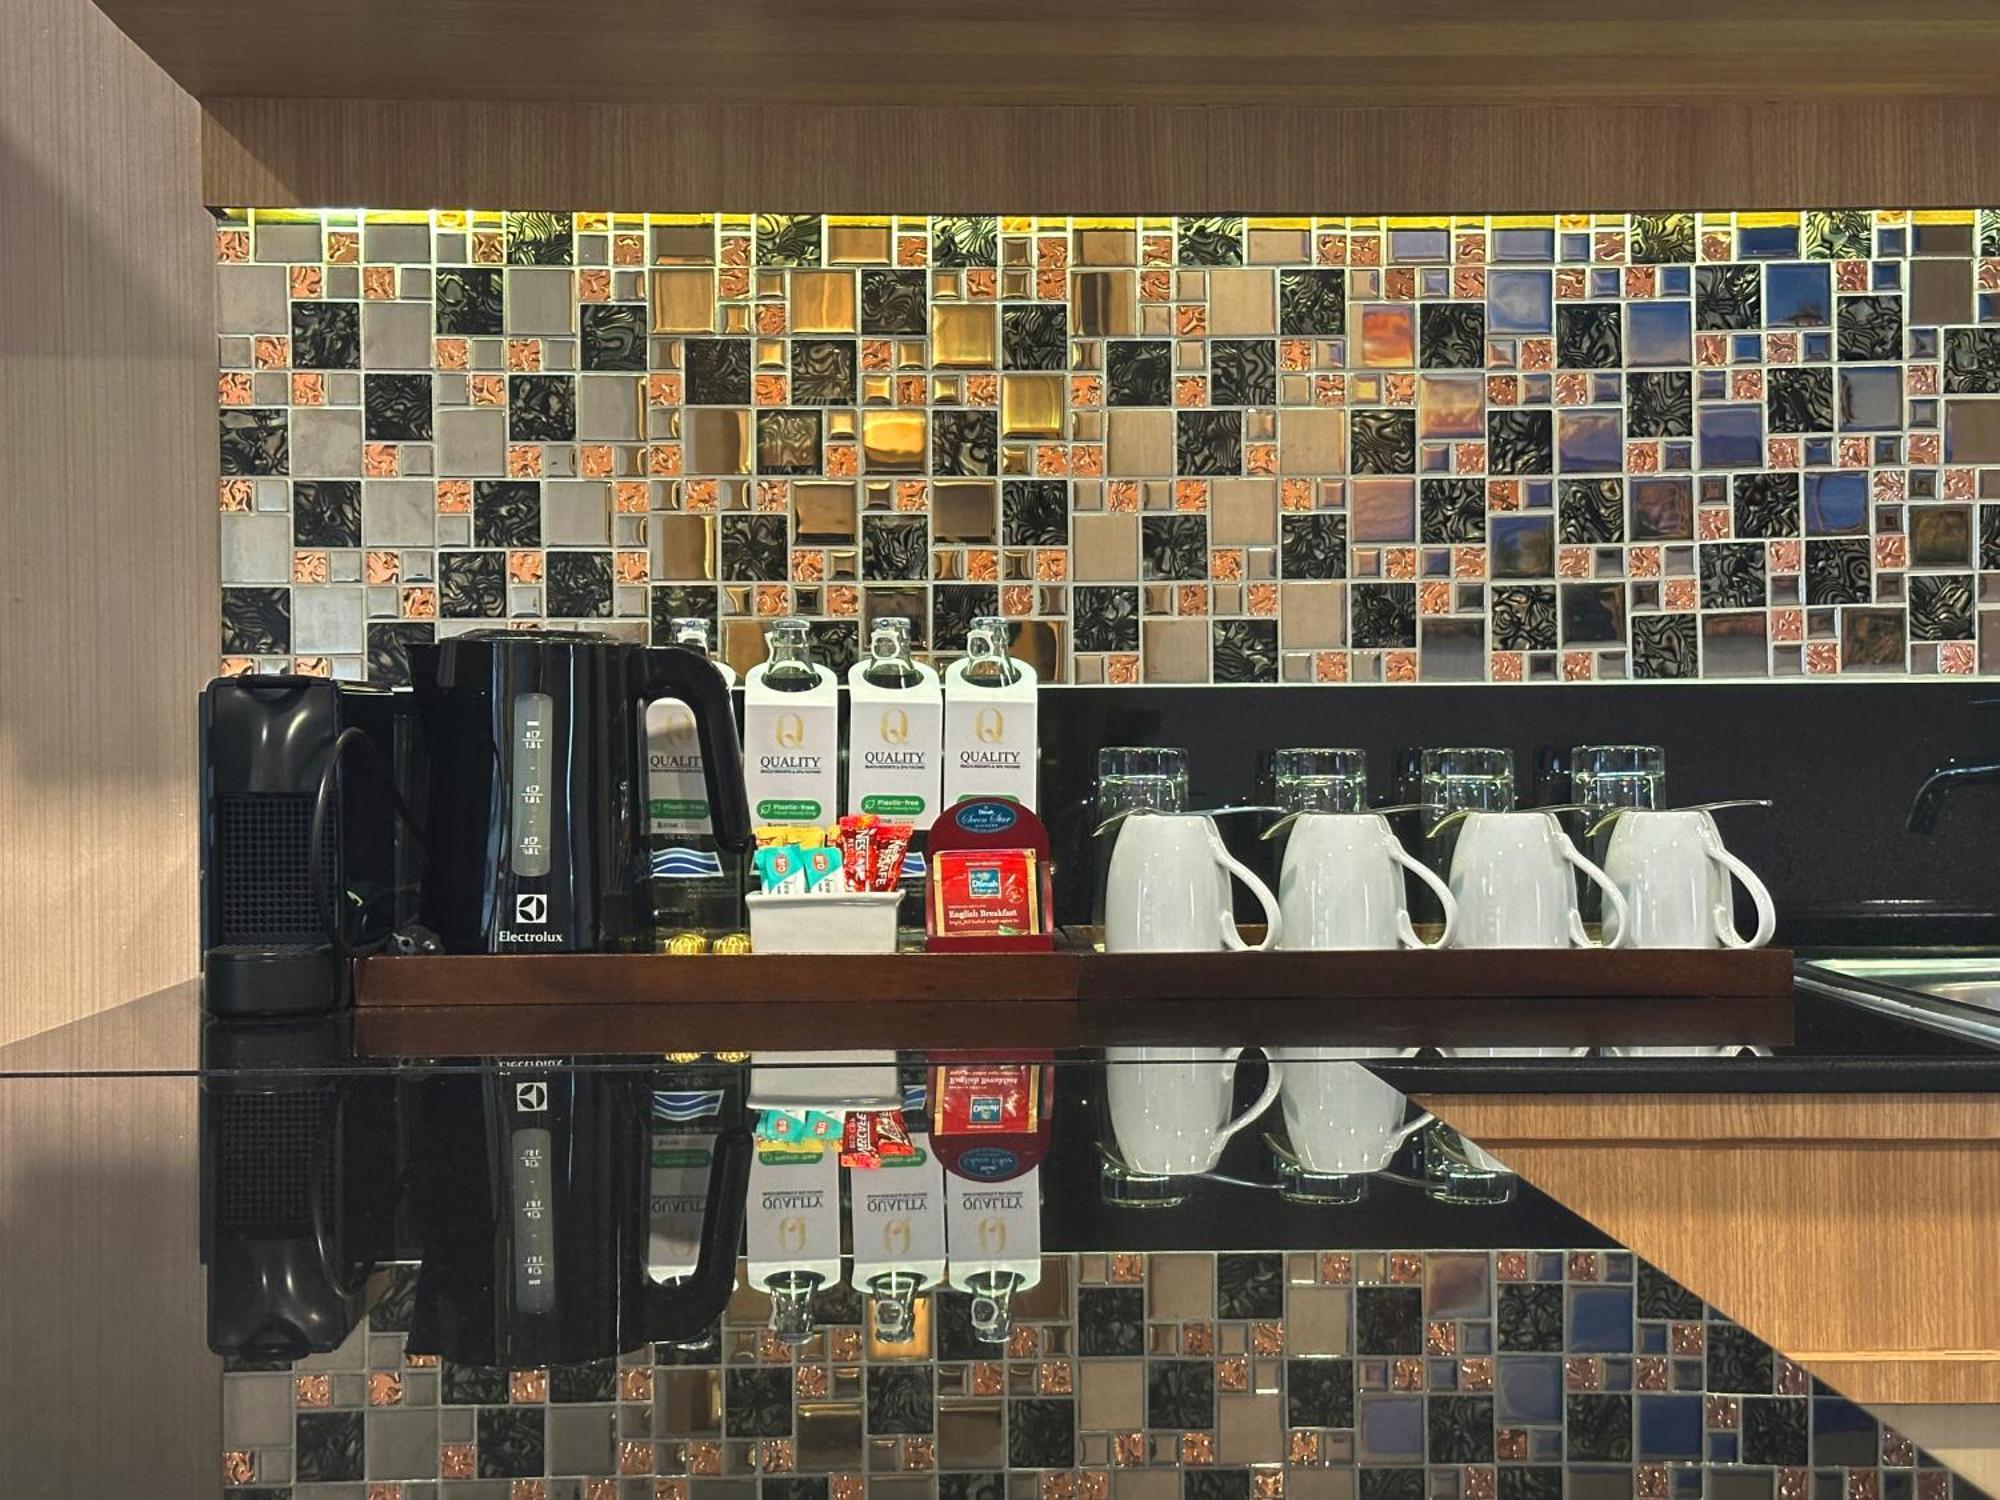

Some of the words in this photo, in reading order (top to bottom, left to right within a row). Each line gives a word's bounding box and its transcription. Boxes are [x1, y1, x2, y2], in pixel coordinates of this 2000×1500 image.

[775, 712, 804, 750] Q
[879, 706, 908, 746] Q
[976, 706, 1004, 744] Q
[650, 755, 703, 768] QUALIT
[760, 755, 822, 769] QUALITY
[864, 751, 926, 765] QUALITY
[960, 751, 1021, 764] QUALITY
[948, 909, 979, 920] English
[980, 908, 1019, 918] Breakfast
[499, 930, 564, 943] Electrolux
